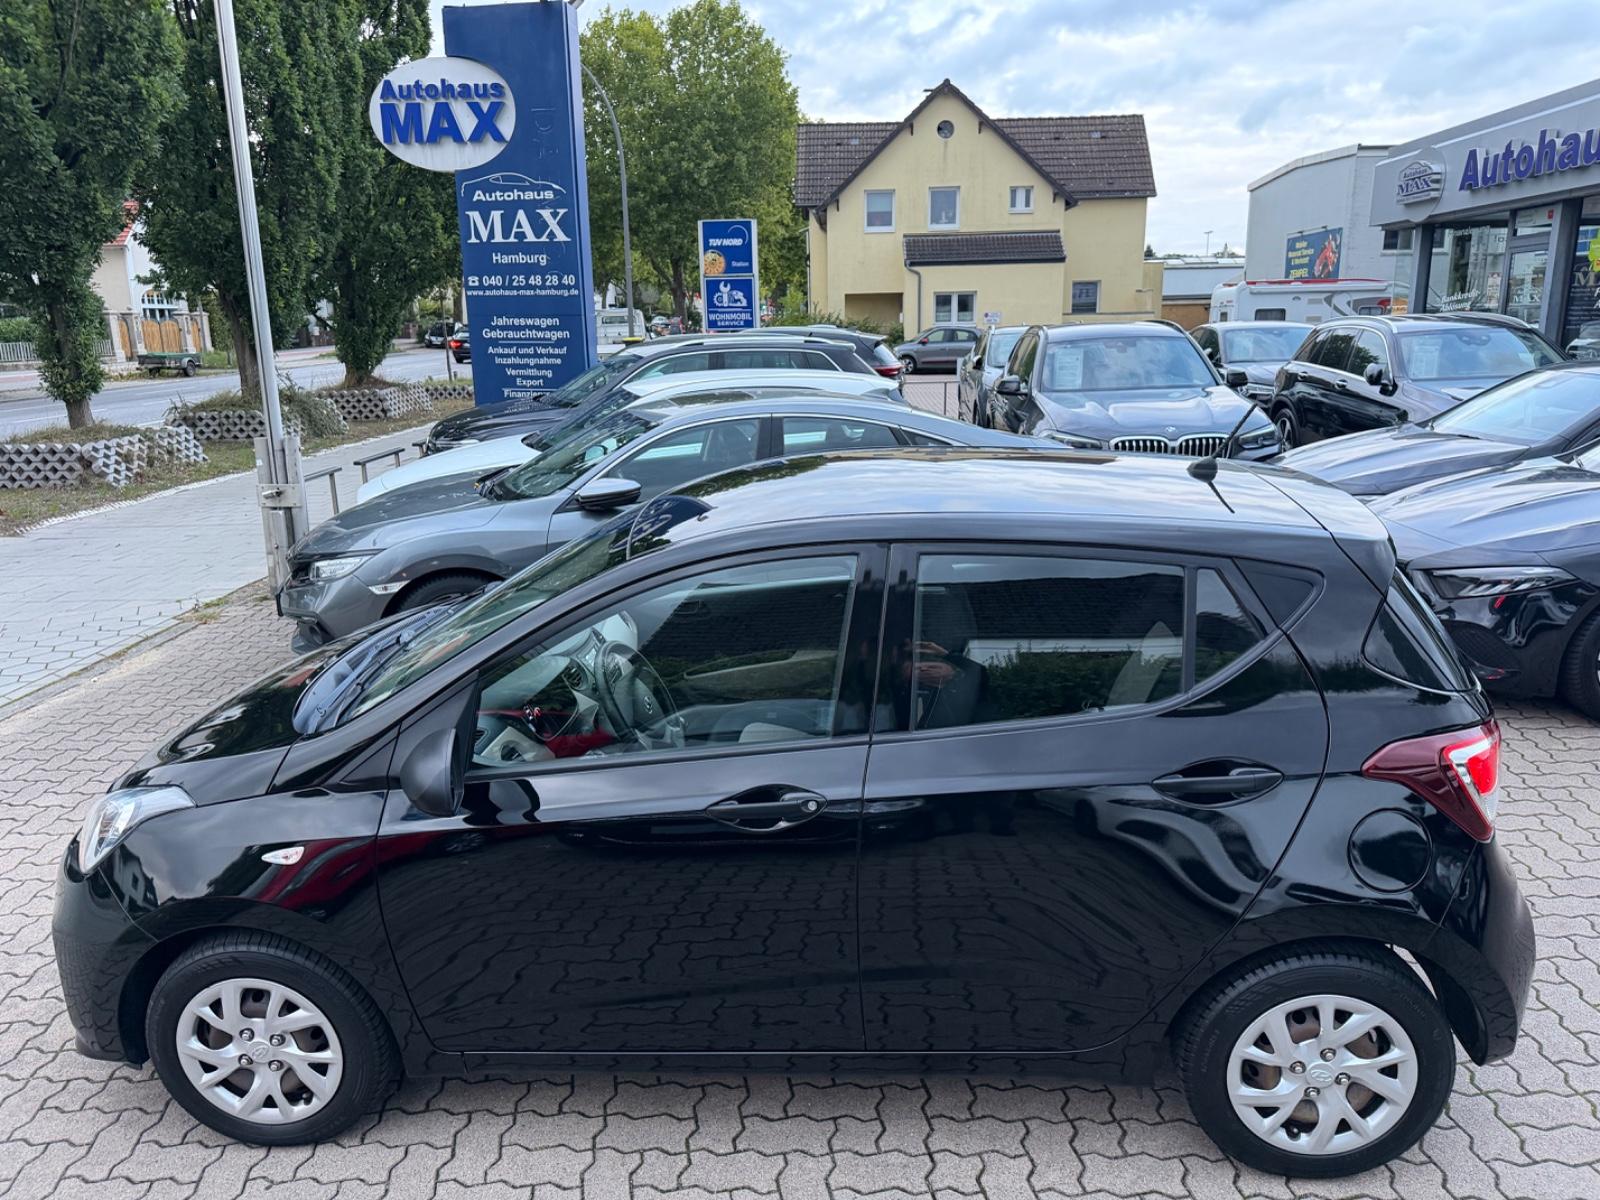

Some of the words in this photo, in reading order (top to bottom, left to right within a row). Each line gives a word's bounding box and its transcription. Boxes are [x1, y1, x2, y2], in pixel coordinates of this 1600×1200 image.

[380, 79, 505, 100] Autohaus
[380, 101, 508, 145] MAX
[1397, 177, 1432, 196] MAX
[472, 188, 554, 202] Autohaus
[465, 208, 571, 243] MAX
[723, 238, 743, 246] NORD
[492, 252, 547, 266] Hamburg
[482, 275, 503, 286] 040
[512, 275, 526, 286] 25
[528, 275, 542, 286] 48
[545, 275, 559, 286] 28
[561, 274, 576, 286] 40
[466, 287, 579, 297] www.autohaus-max-hamburg.de
[491, 316, 560, 328] Jahreswagen
[708, 313, 752, 321] WOHNMOBIL
[482, 328, 571, 341] Gebrauchtwagen
[487, 346, 516, 355] Ankauf
[518, 346, 534, 355] und
[536, 346, 567, 355] Verkauf
[495, 356, 562, 366] Inzahlungnahme
[505, 367, 553, 378] Vermittlung
[516, 378, 544, 388] Export
